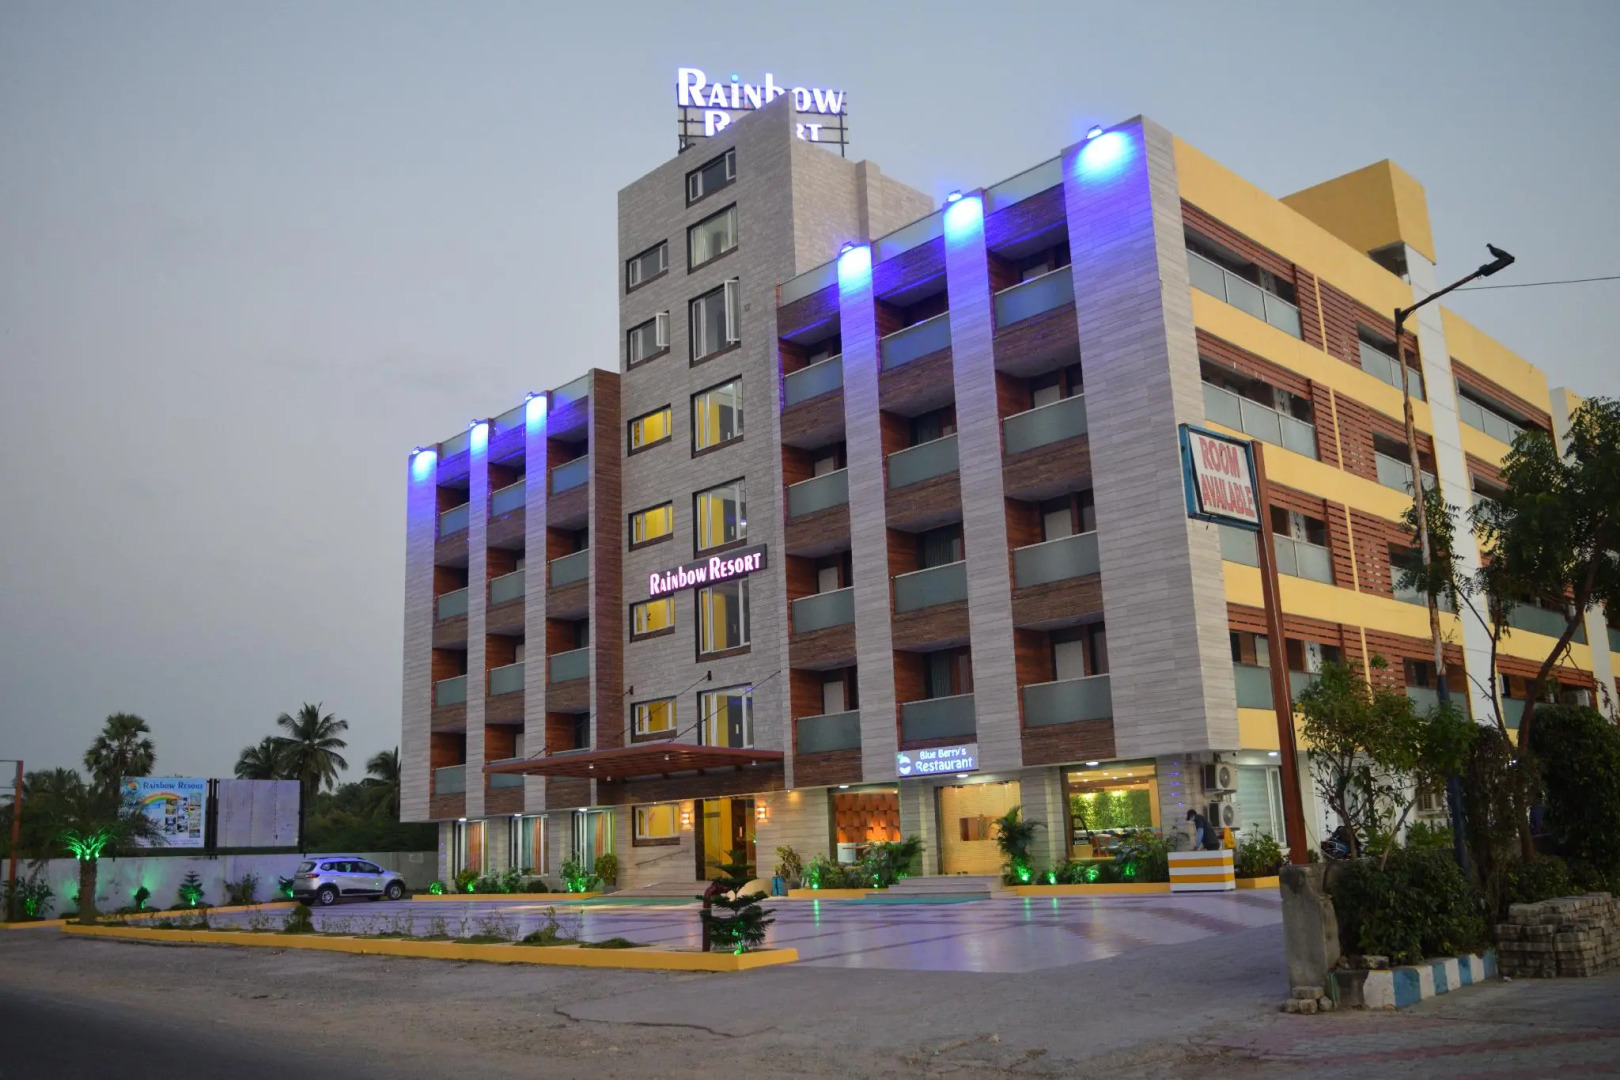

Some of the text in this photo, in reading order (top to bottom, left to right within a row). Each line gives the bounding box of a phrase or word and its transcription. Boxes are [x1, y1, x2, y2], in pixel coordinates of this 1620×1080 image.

[1198, 436, 1241, 478] ROOM
[1200, 473, 1256, 518] AVAILABLE
[709, 552, 761, 580] RESORT
[915, 756, 973, 773] Restaurant
[919, 747, 967, 760] Blue Berry's
